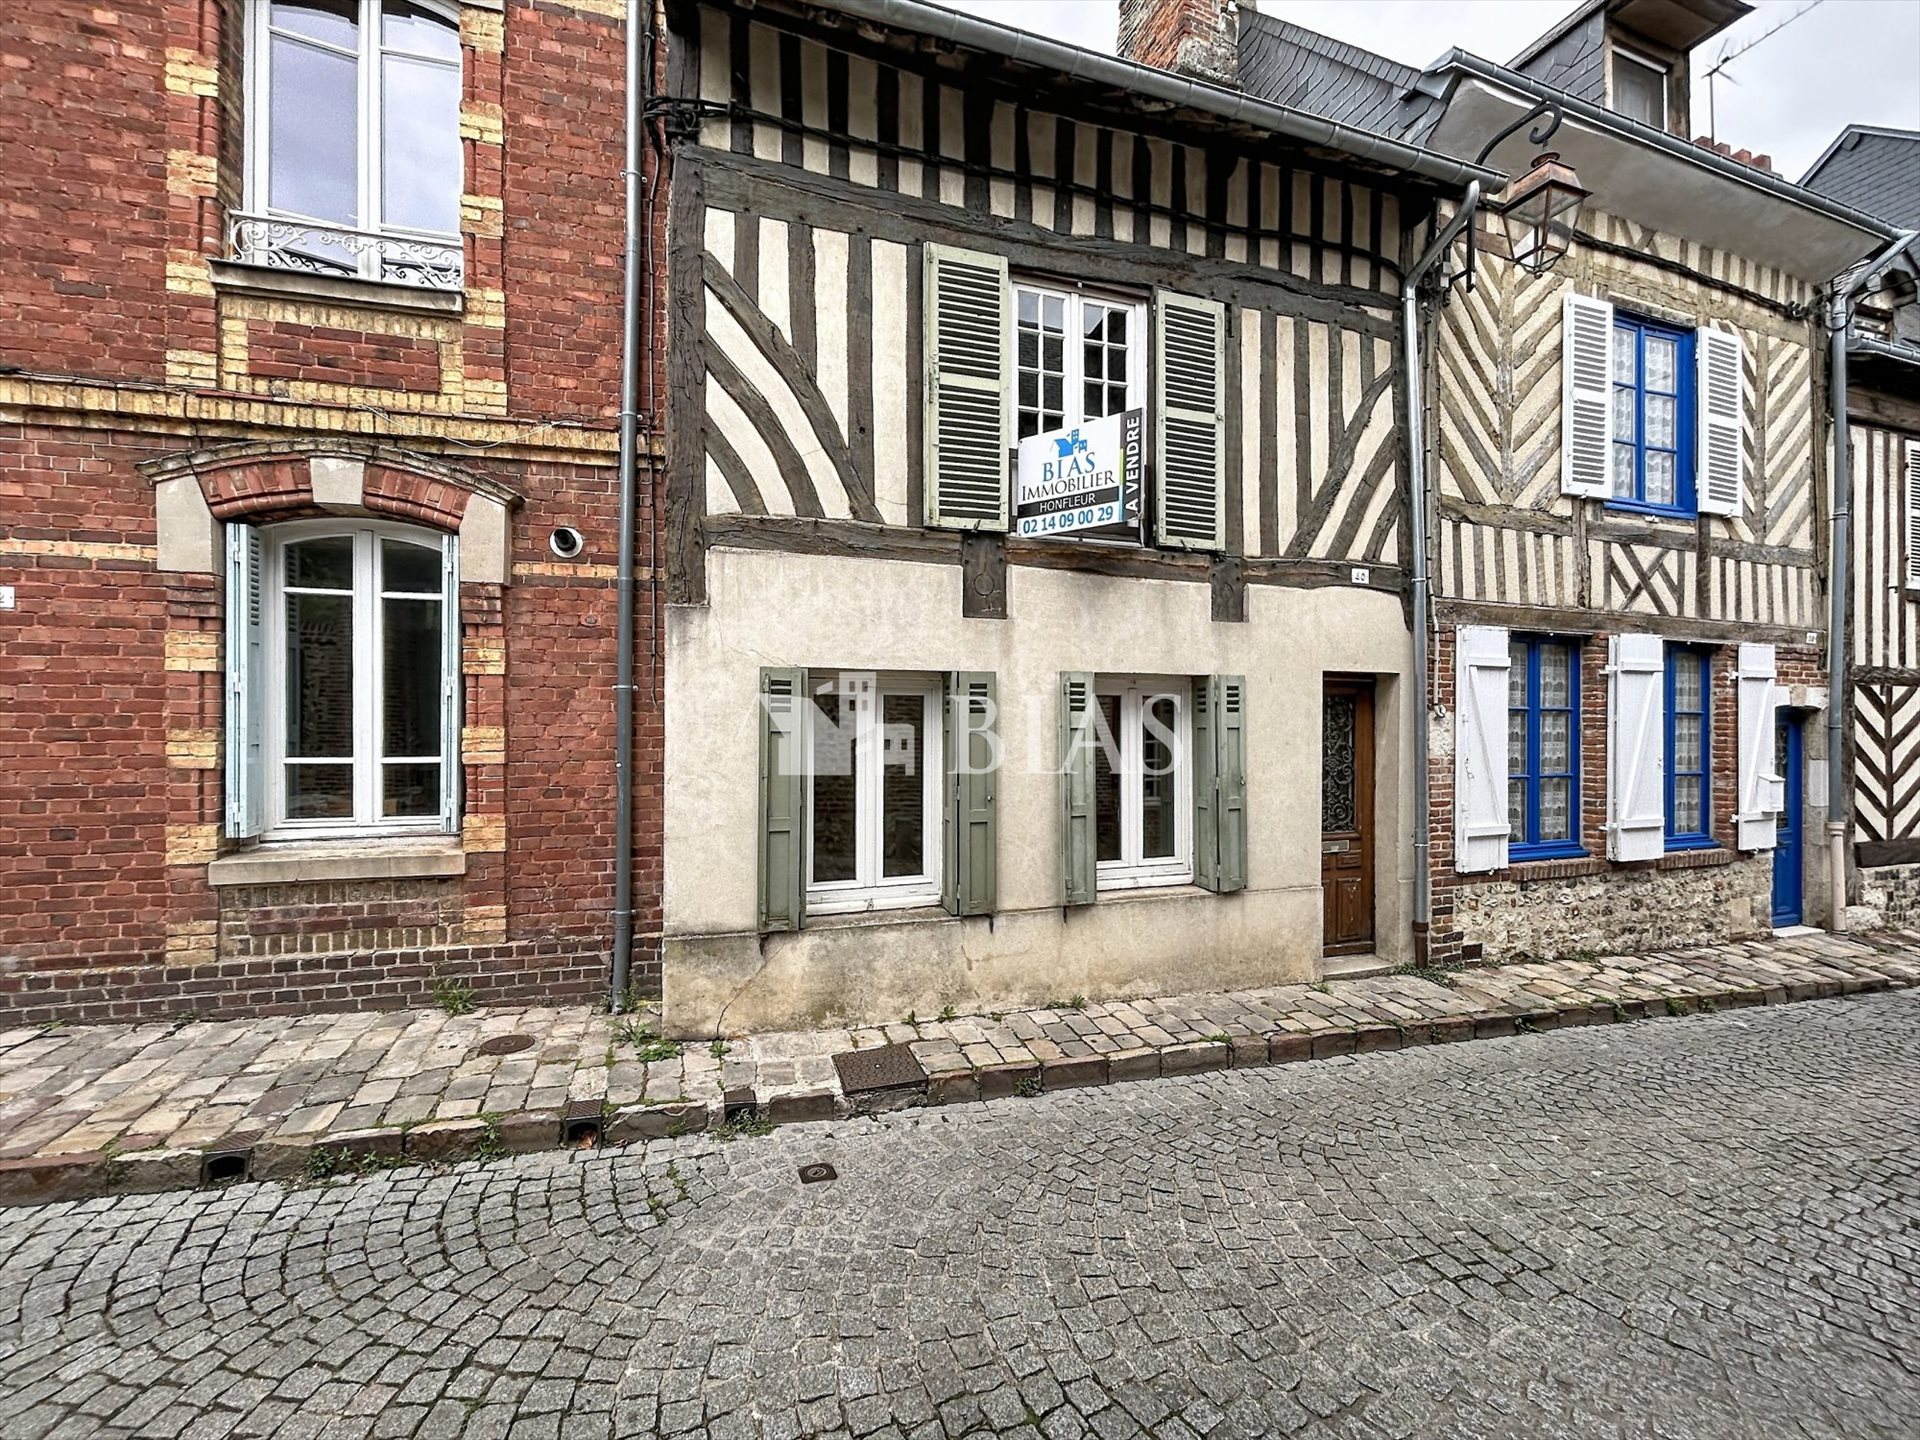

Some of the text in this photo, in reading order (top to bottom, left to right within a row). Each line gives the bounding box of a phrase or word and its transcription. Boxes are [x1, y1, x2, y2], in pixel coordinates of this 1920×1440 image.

[1042, 452, 1096, 482] BIAS
[1125, 416, 1140, 511] A VENDRE
[1022, 470, 1116, 501] IMMOBILIER
[1039, 493, 1096, 513] HONFLEUR
[1022, 505, 1114, 534] 02 14 09 00 29
